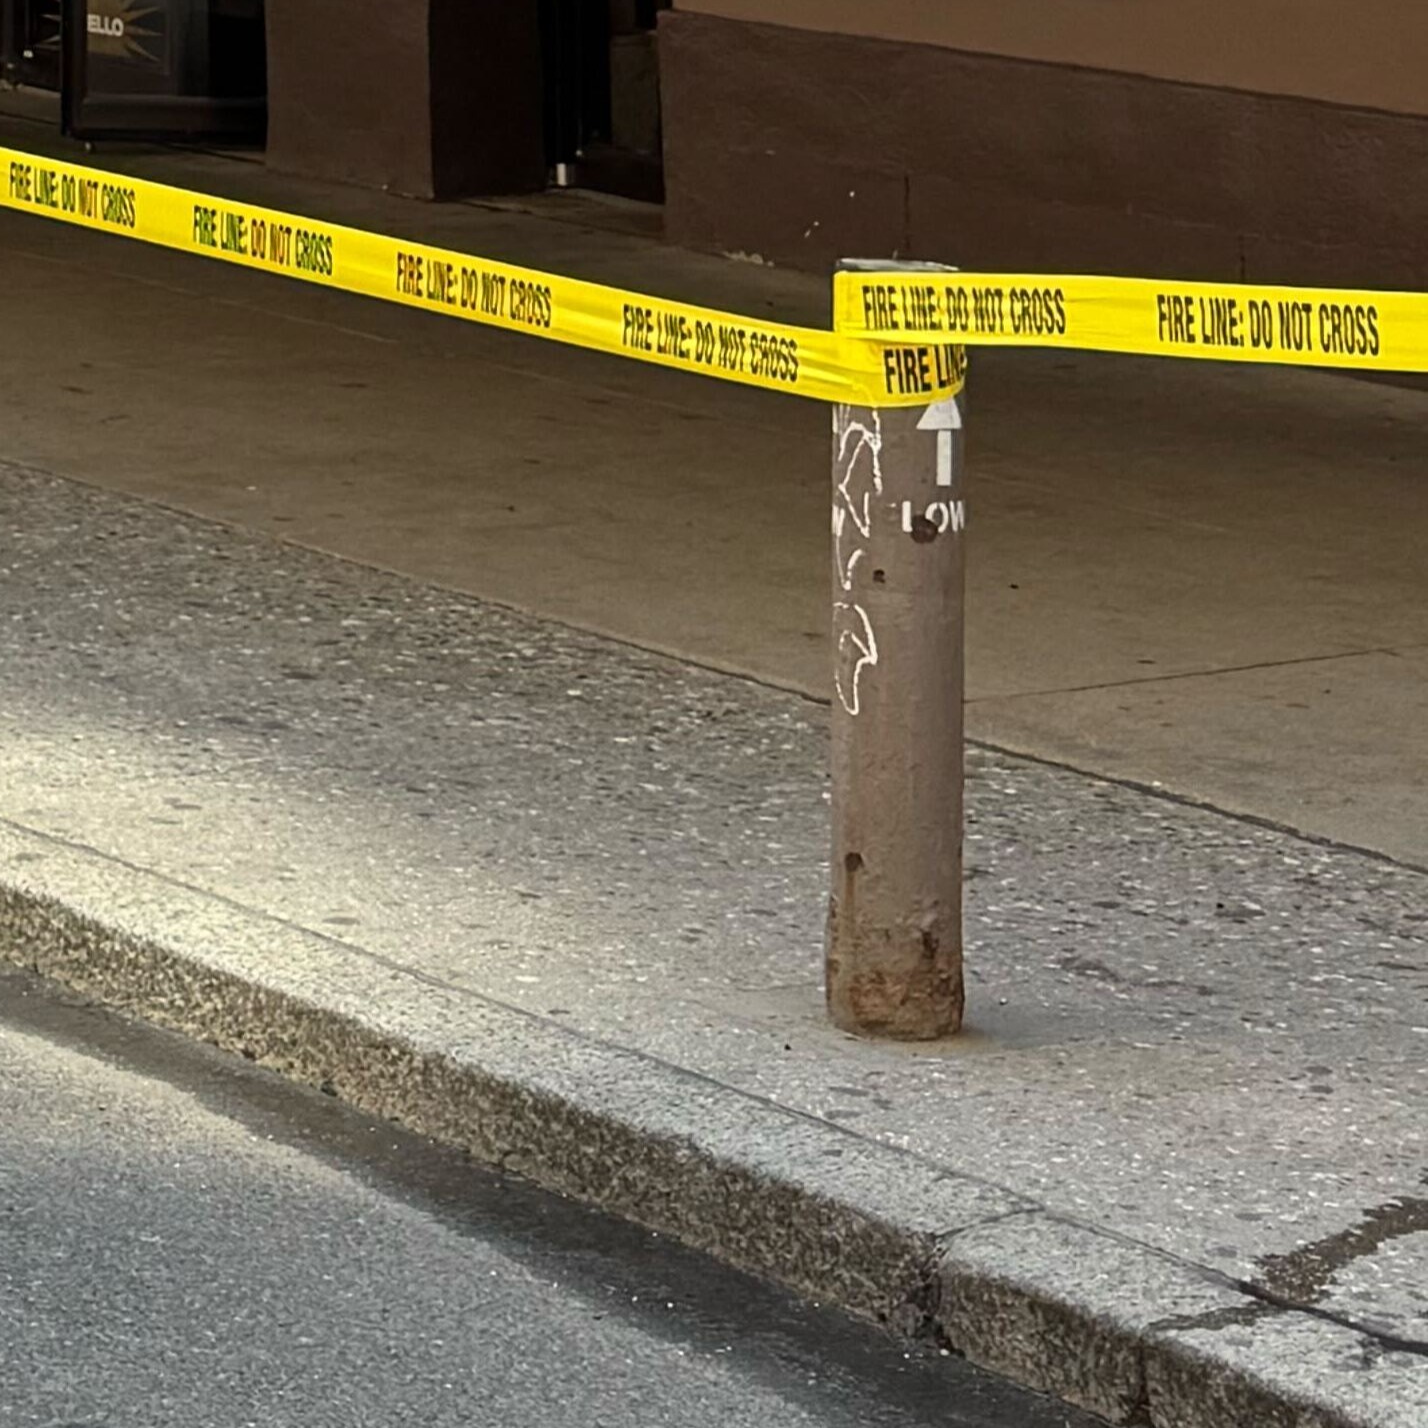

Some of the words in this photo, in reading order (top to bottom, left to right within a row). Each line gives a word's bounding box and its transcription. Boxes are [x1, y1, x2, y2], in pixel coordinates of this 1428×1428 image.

[87, 14, 124, 37] ELLO
[10, 161, 31, 201] FIRE
[62, 174, 76, 213] DO
[79, 178, 98, 219] NOT
[101, 183, 135, 228] CROSS
[193, 205, 217, 247] FIRE
[251, 219, 266, 259] DO
[270, 223, 292, 266] NOT
[295, 229, 332, 276] CROSS
[397, 251, 423, 298] FIRE
[461, 266, 477, 311] DO
[481, 271, 505, 317] NOT
[510, 278, 551, 328] CROSS
[862, 284, 899, 331] FIRE
[945, 286, 969, 331] DO
[972, 287, 1004, 333] NOT
[1010, 287, 1066, 335] CROSS
[623, 303, 654, 352] FIRE
[695, 320, 715, 365] DO
[719, 325, 746, 372] NOT
[749, 331, 799, 383] CROSS
[1157, 294, 1195, 343] FIRE
[1248, 299, 1273, 349] DO
[1278, 301, 1313, 352] NOT
[1319, 303, 1380, 356] CROSS
[884, 347, 932, 394] FIRE
